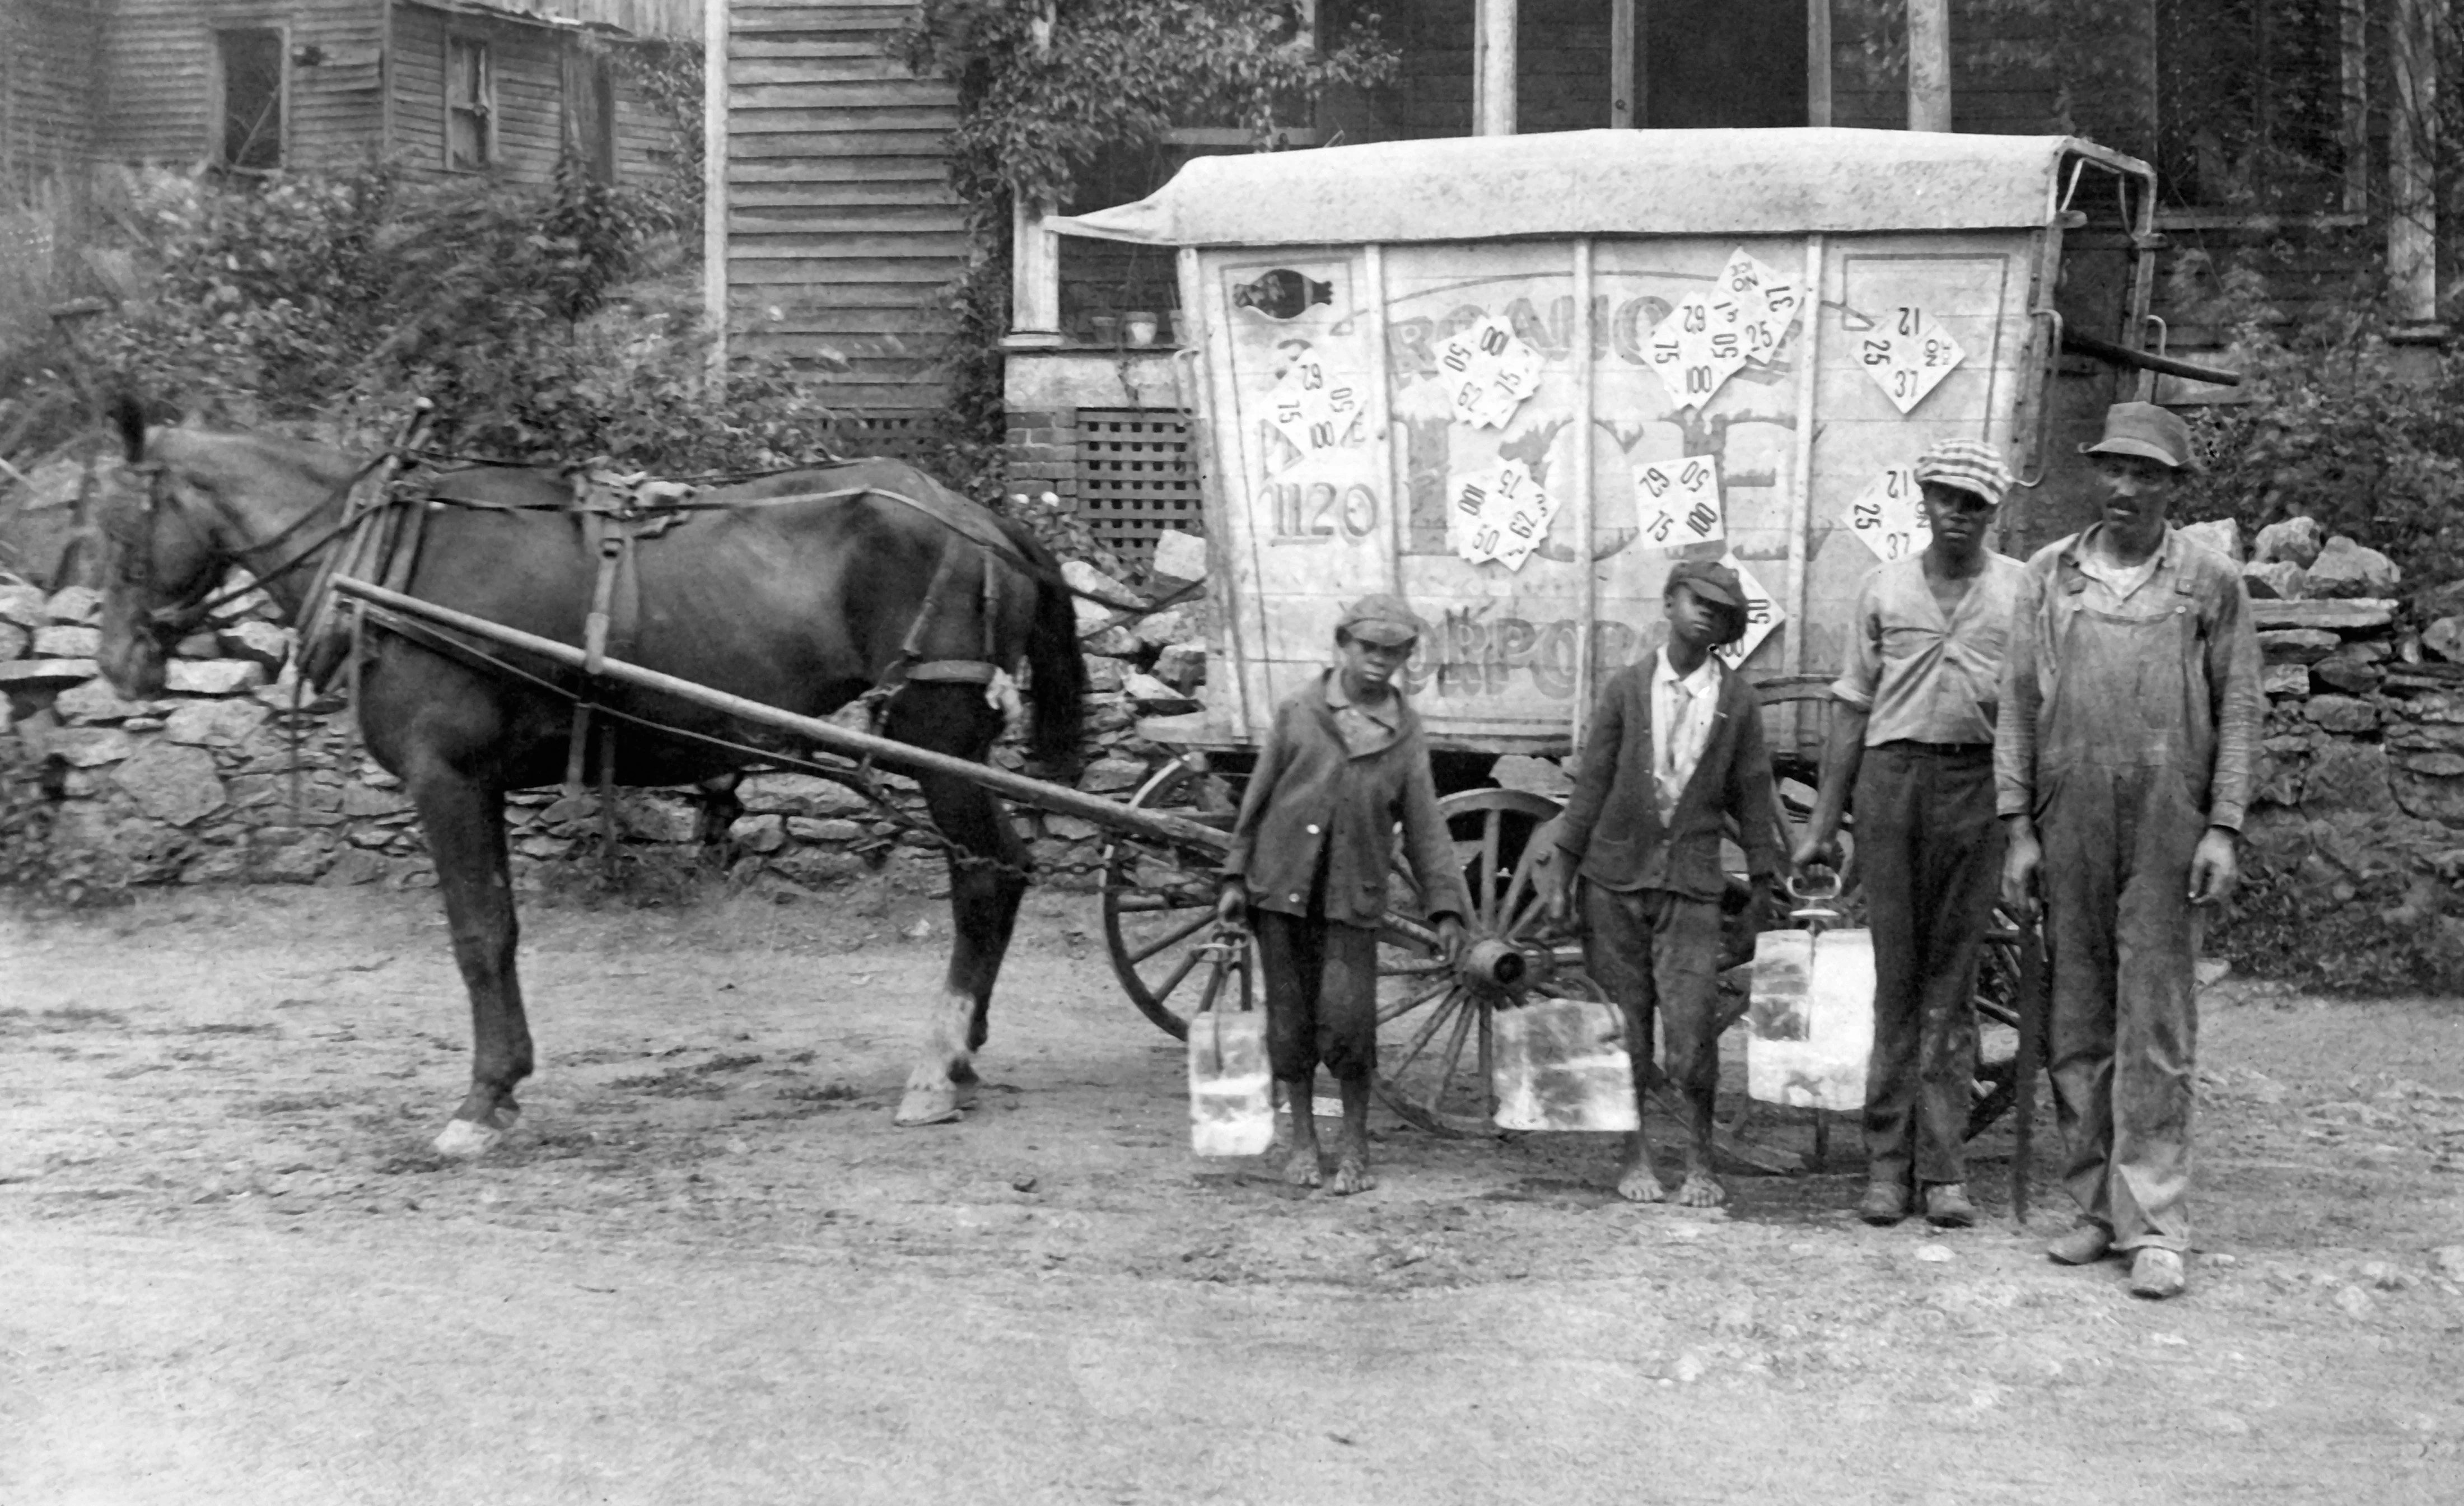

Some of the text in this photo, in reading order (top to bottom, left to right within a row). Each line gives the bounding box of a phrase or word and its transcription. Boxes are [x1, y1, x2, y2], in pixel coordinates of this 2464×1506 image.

[1765, 285, 1795, 313] 37
[1683, 304, 1706, 334] 62
[1898, 306, 1919, 336] 12
[1389, 294, 1804, 388] RANO
[1710, 333, 1739, 358] 50
[1745, 320, 1773, 352] 25
[1443, 342, 1472, 372] 50
[1654, 339, 1680, 364] 75
[1863, 339, 1891, 366] 25
[1924, 338, 1939, 367] NO
[1299, 362, 1323, 391] 62
[1494, 371, 1522, 395] 75
[1686, 365, 1712, 394] 100
[1894, 369, 1919, 398] 37
[1328, 387, 1355, 413] 50
[1457, 381, 1483, 412] 62
[1277, 400, 1303, 423] 75
[1393, 414, 1830, 562] ICE
[1497, 469, 1522, 500] 75
[1639, 467, 1670, 498] 62
[1679, 460, 1710, 492] 50
[1886, 469, 1908, 498] 12
[1258, 482, 1380, 545] 1120
[1457, 483, 1487, 516] 100
[1509, 510, 1539, 539] 62
[1646, 510, 1675, 542] 75
[1686, 502, 1719, 538] 100
[1854, 503, 1882, 529] 25
[1471, 524, 1501, 556] 50
[1886, 531, 1911, 560] 37
